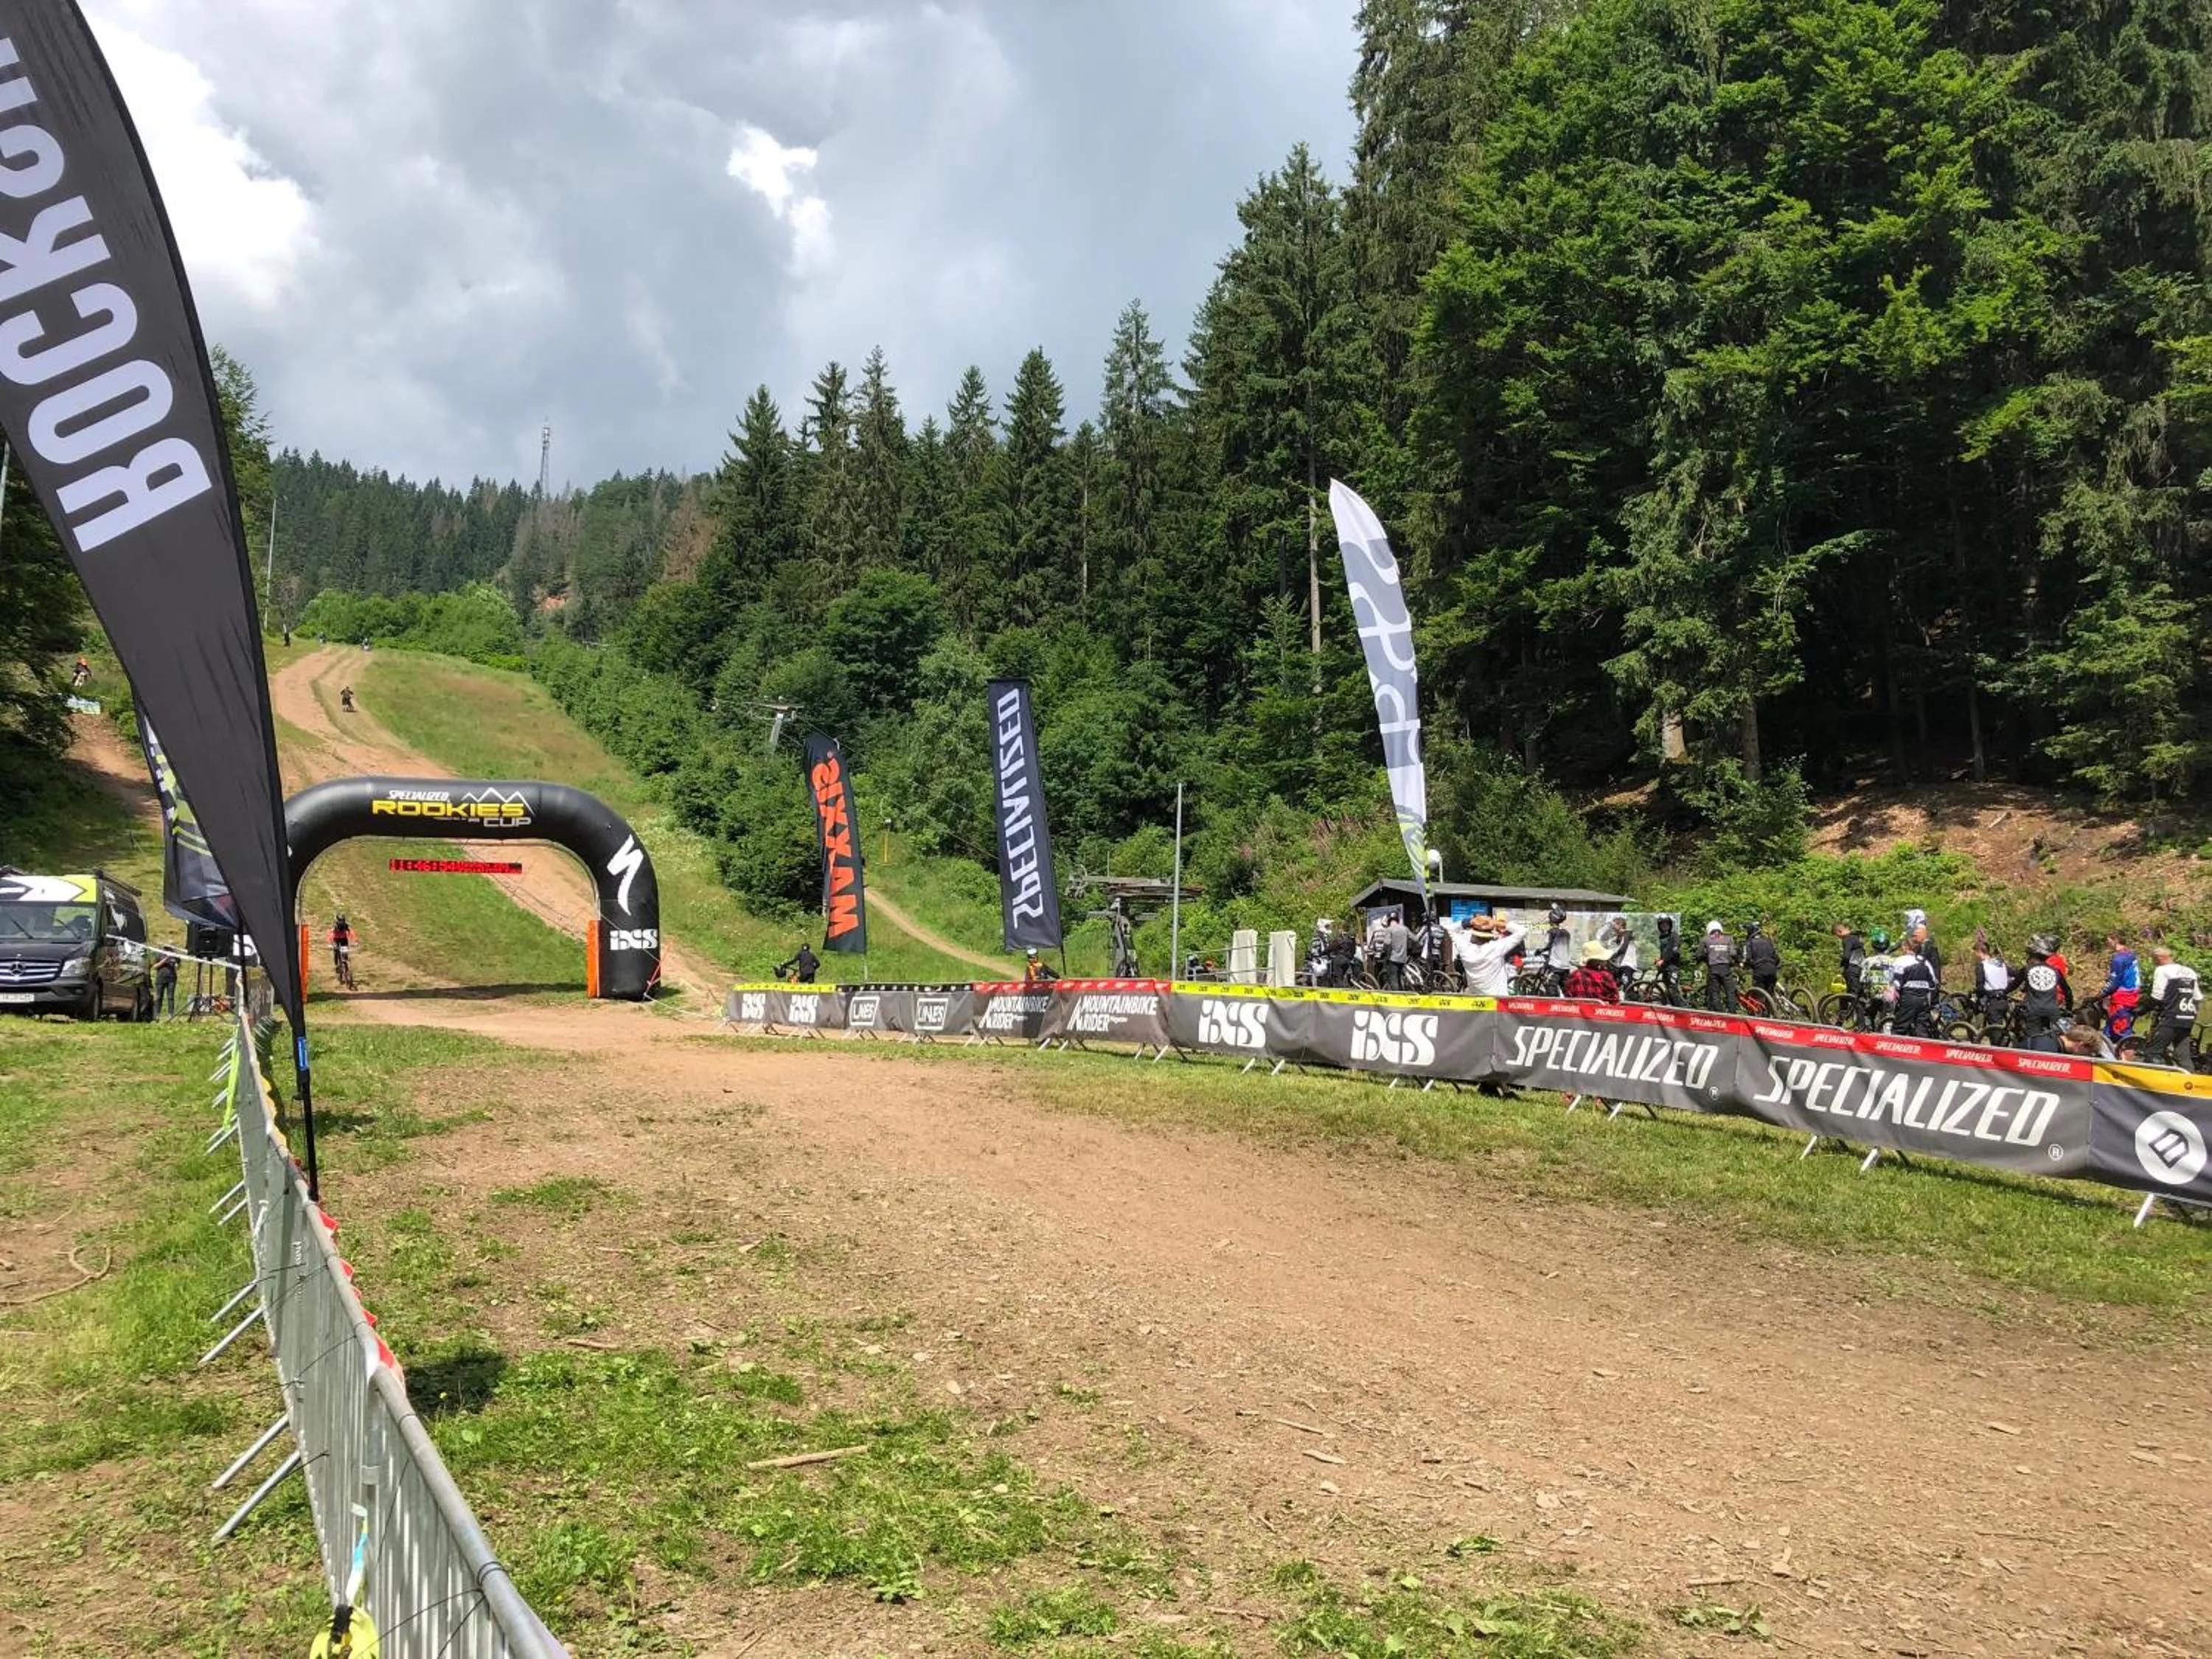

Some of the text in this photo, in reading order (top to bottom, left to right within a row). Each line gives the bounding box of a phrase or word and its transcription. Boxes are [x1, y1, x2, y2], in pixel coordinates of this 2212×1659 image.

[388, 790, 451, 801] SPECIALIZED
[372, 800, 524, 817] ROOKIES
[483, 817, 532, 828] CUP
[1080, 995, 1158, 1015] MOUNTAINBIKE
[2179, 998, 2194, 1012] 66
[1081, 1015, 1110, 1032] RIDER
[1506, 1026, 1719, 1089] SPECIALIZED
[1753, 1055, 2061, 1147] SPECIALIZED
